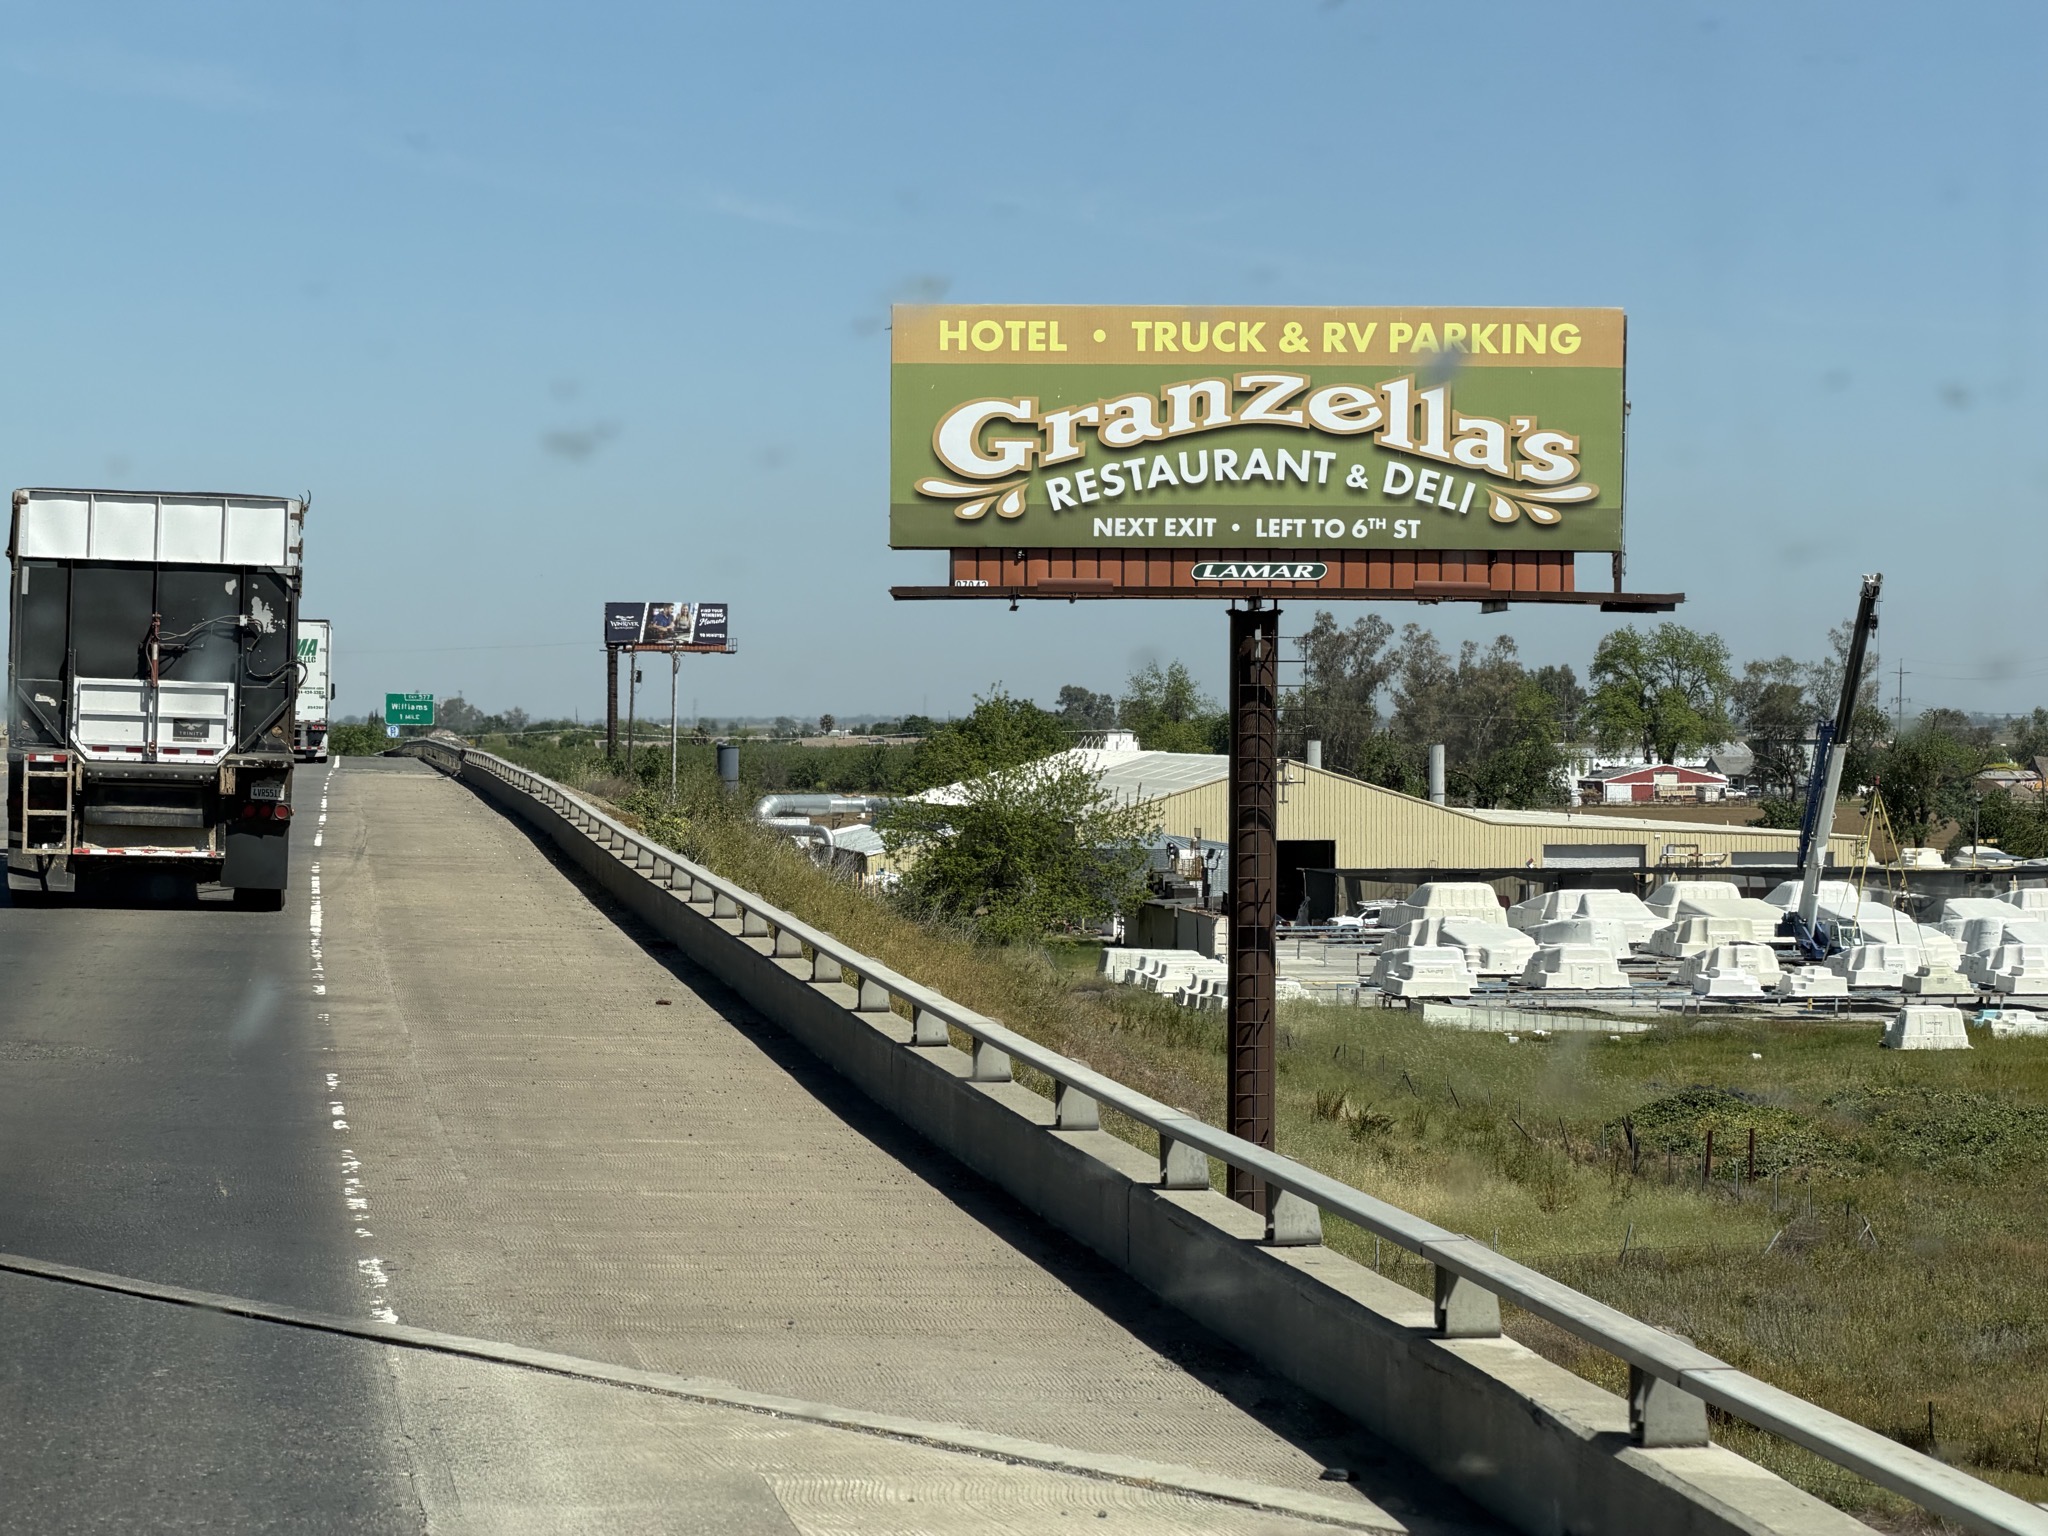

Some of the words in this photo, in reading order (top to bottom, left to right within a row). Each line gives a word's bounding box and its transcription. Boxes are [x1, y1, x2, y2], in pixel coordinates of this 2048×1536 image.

[939, 320, 1067, 351] HOTEL
[1131, 321, 1267, 352] TRUCK
[1278, 322, 1310, 353] &
[1323, 322, 1377, 353] RV
[1389, 323, 1582, 354] PARKING
[936, 373, 1577, 482] Granzella's
[1045, 448, 1336, 511] RESTAURANT
[1346, 464, 1368, 490] &
[1383, 461, 1476, 514] DELI
[1093, 518, 1157, 537] NEXT
[1165, 518, 1217, 537] EXIT
[1256, 518, 1306, 538] LEFT
[1312, 518, 1345, 539] TO
[1352, 518, 1386, 539] 6TH
[1393, 519, 1421, 539] ST
[1203, 564, 1313, 579] LAMAR
[699, 616, 726, 626] Moment
[391, 703, 428, 711] Williams
